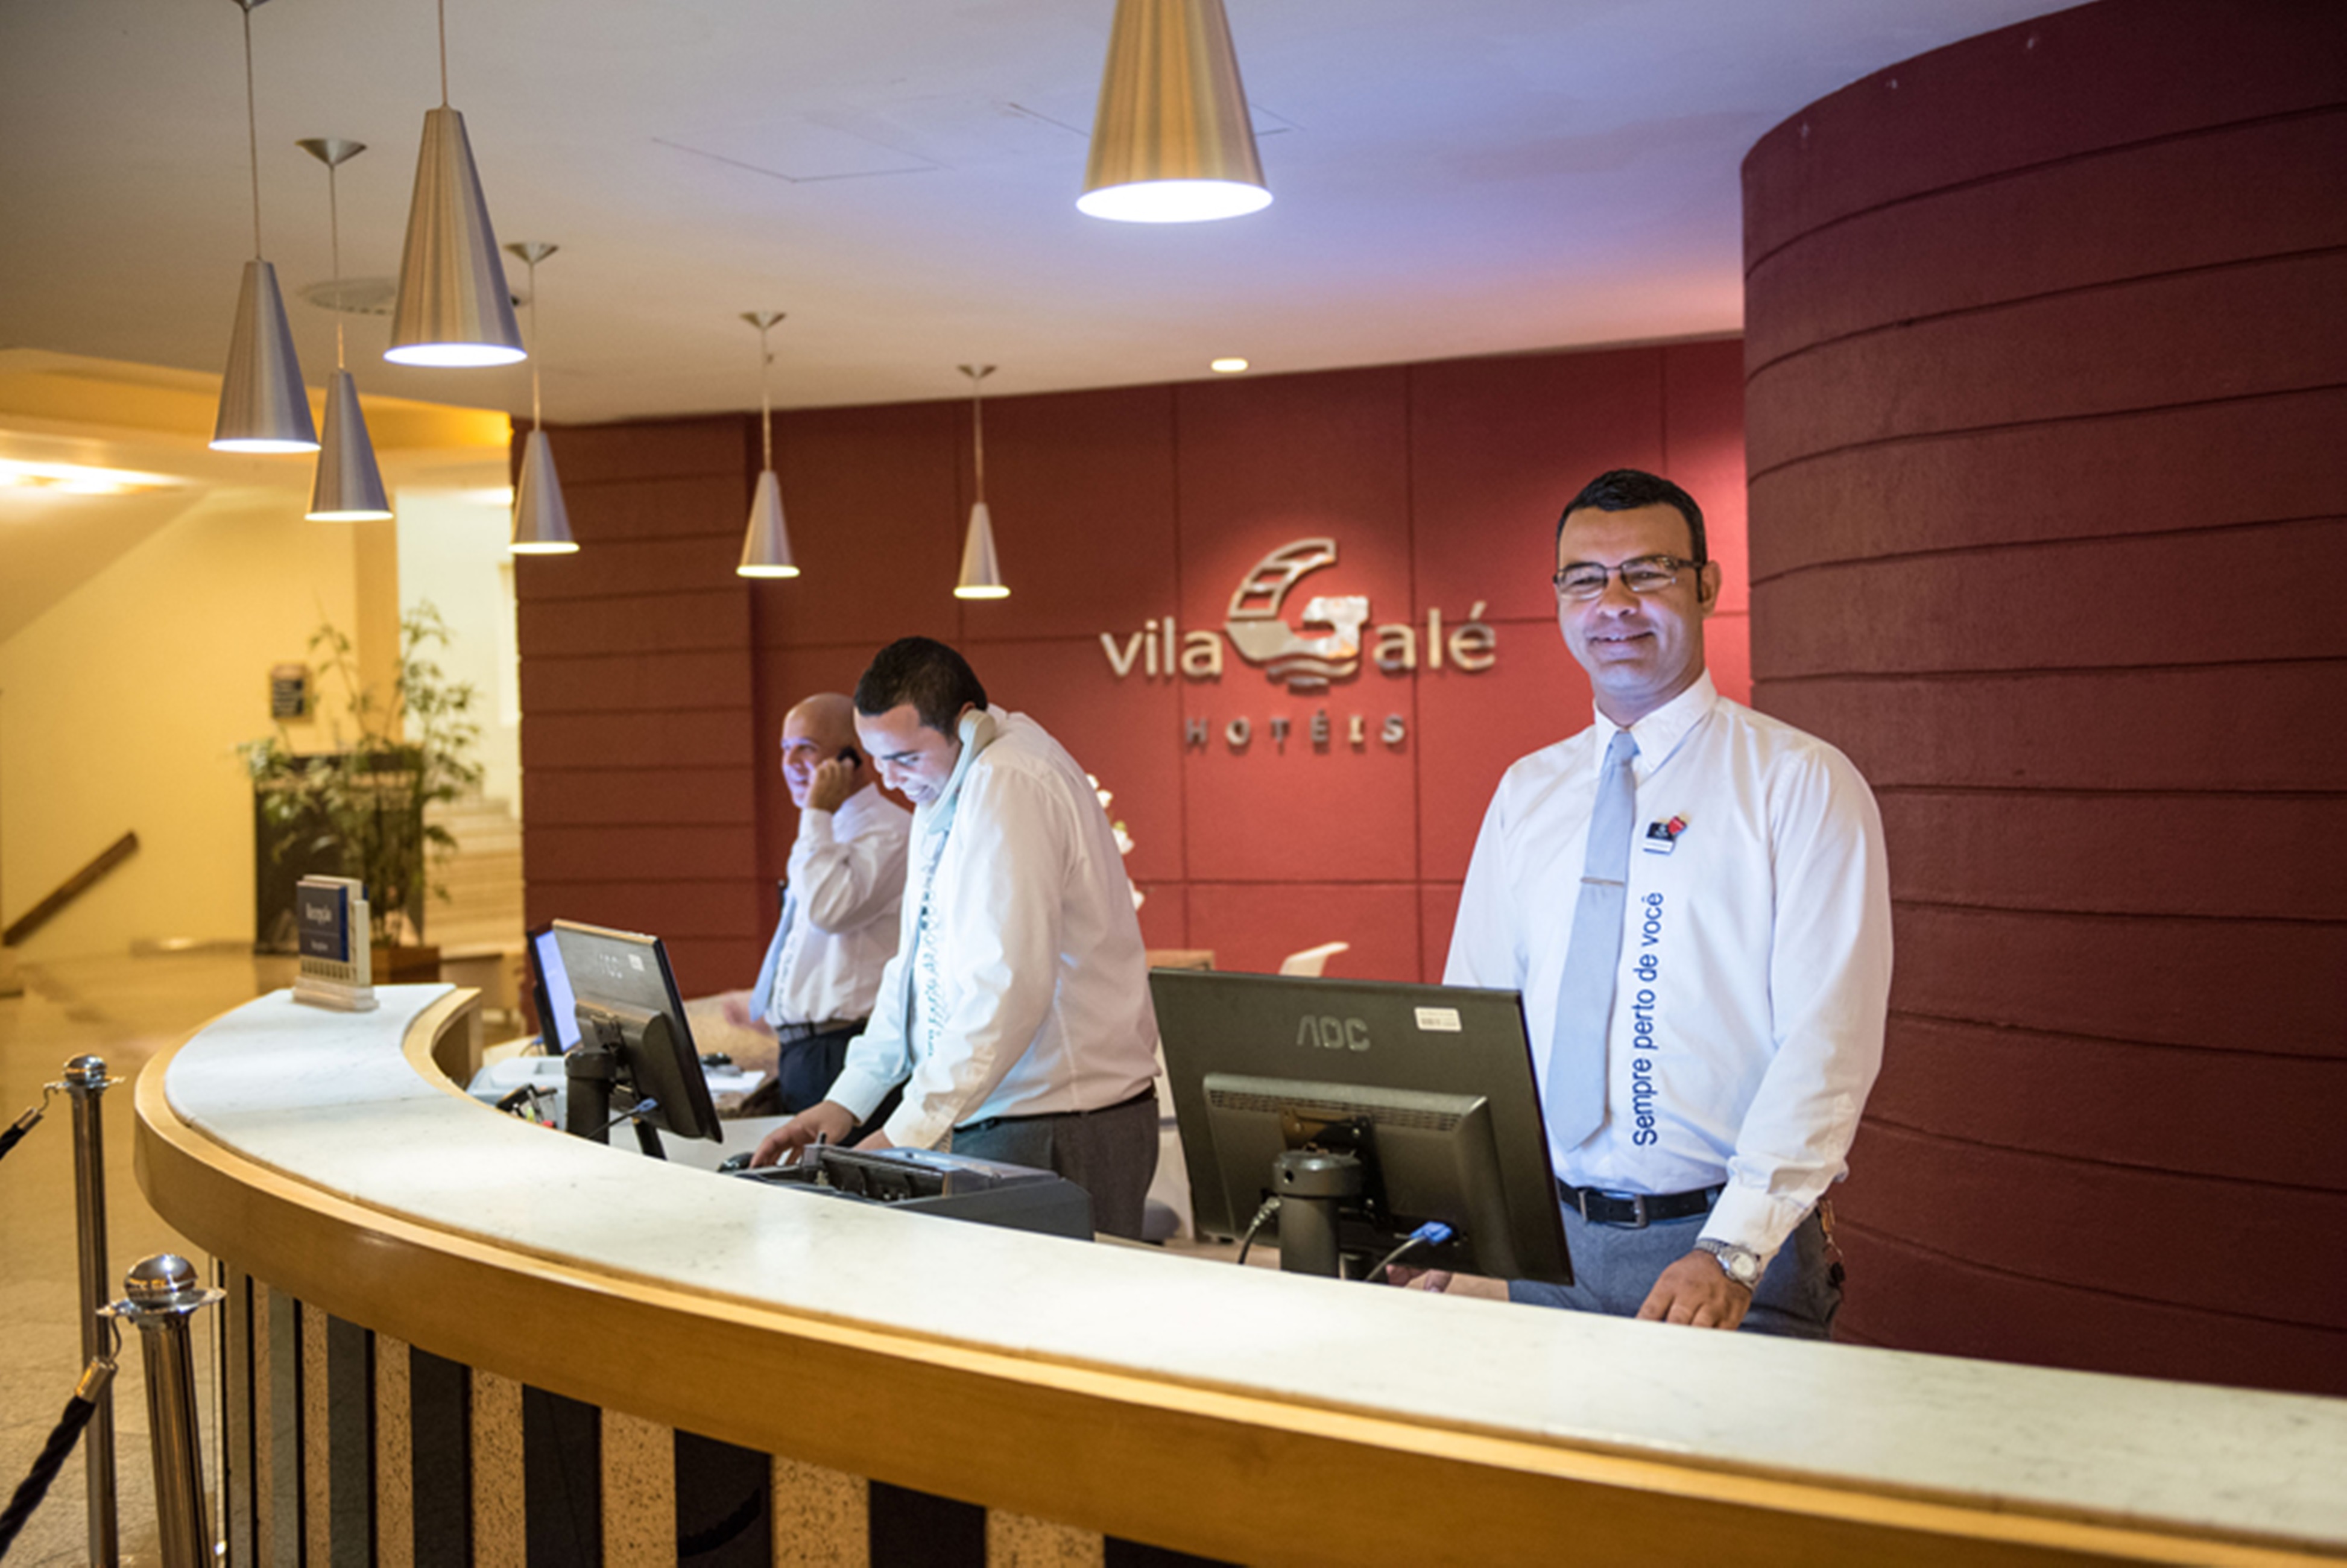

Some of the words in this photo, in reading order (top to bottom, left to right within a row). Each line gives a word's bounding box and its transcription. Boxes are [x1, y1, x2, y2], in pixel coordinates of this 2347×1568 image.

[1186, 710, 1405, 748] HOTÉIS
[1640, 892, 1664, 947] você
[1634, 953, 1658, 982] de
[1632, 989, 1658, 1049] perto
[1632, 1057, 1658, 1146] Sempre
